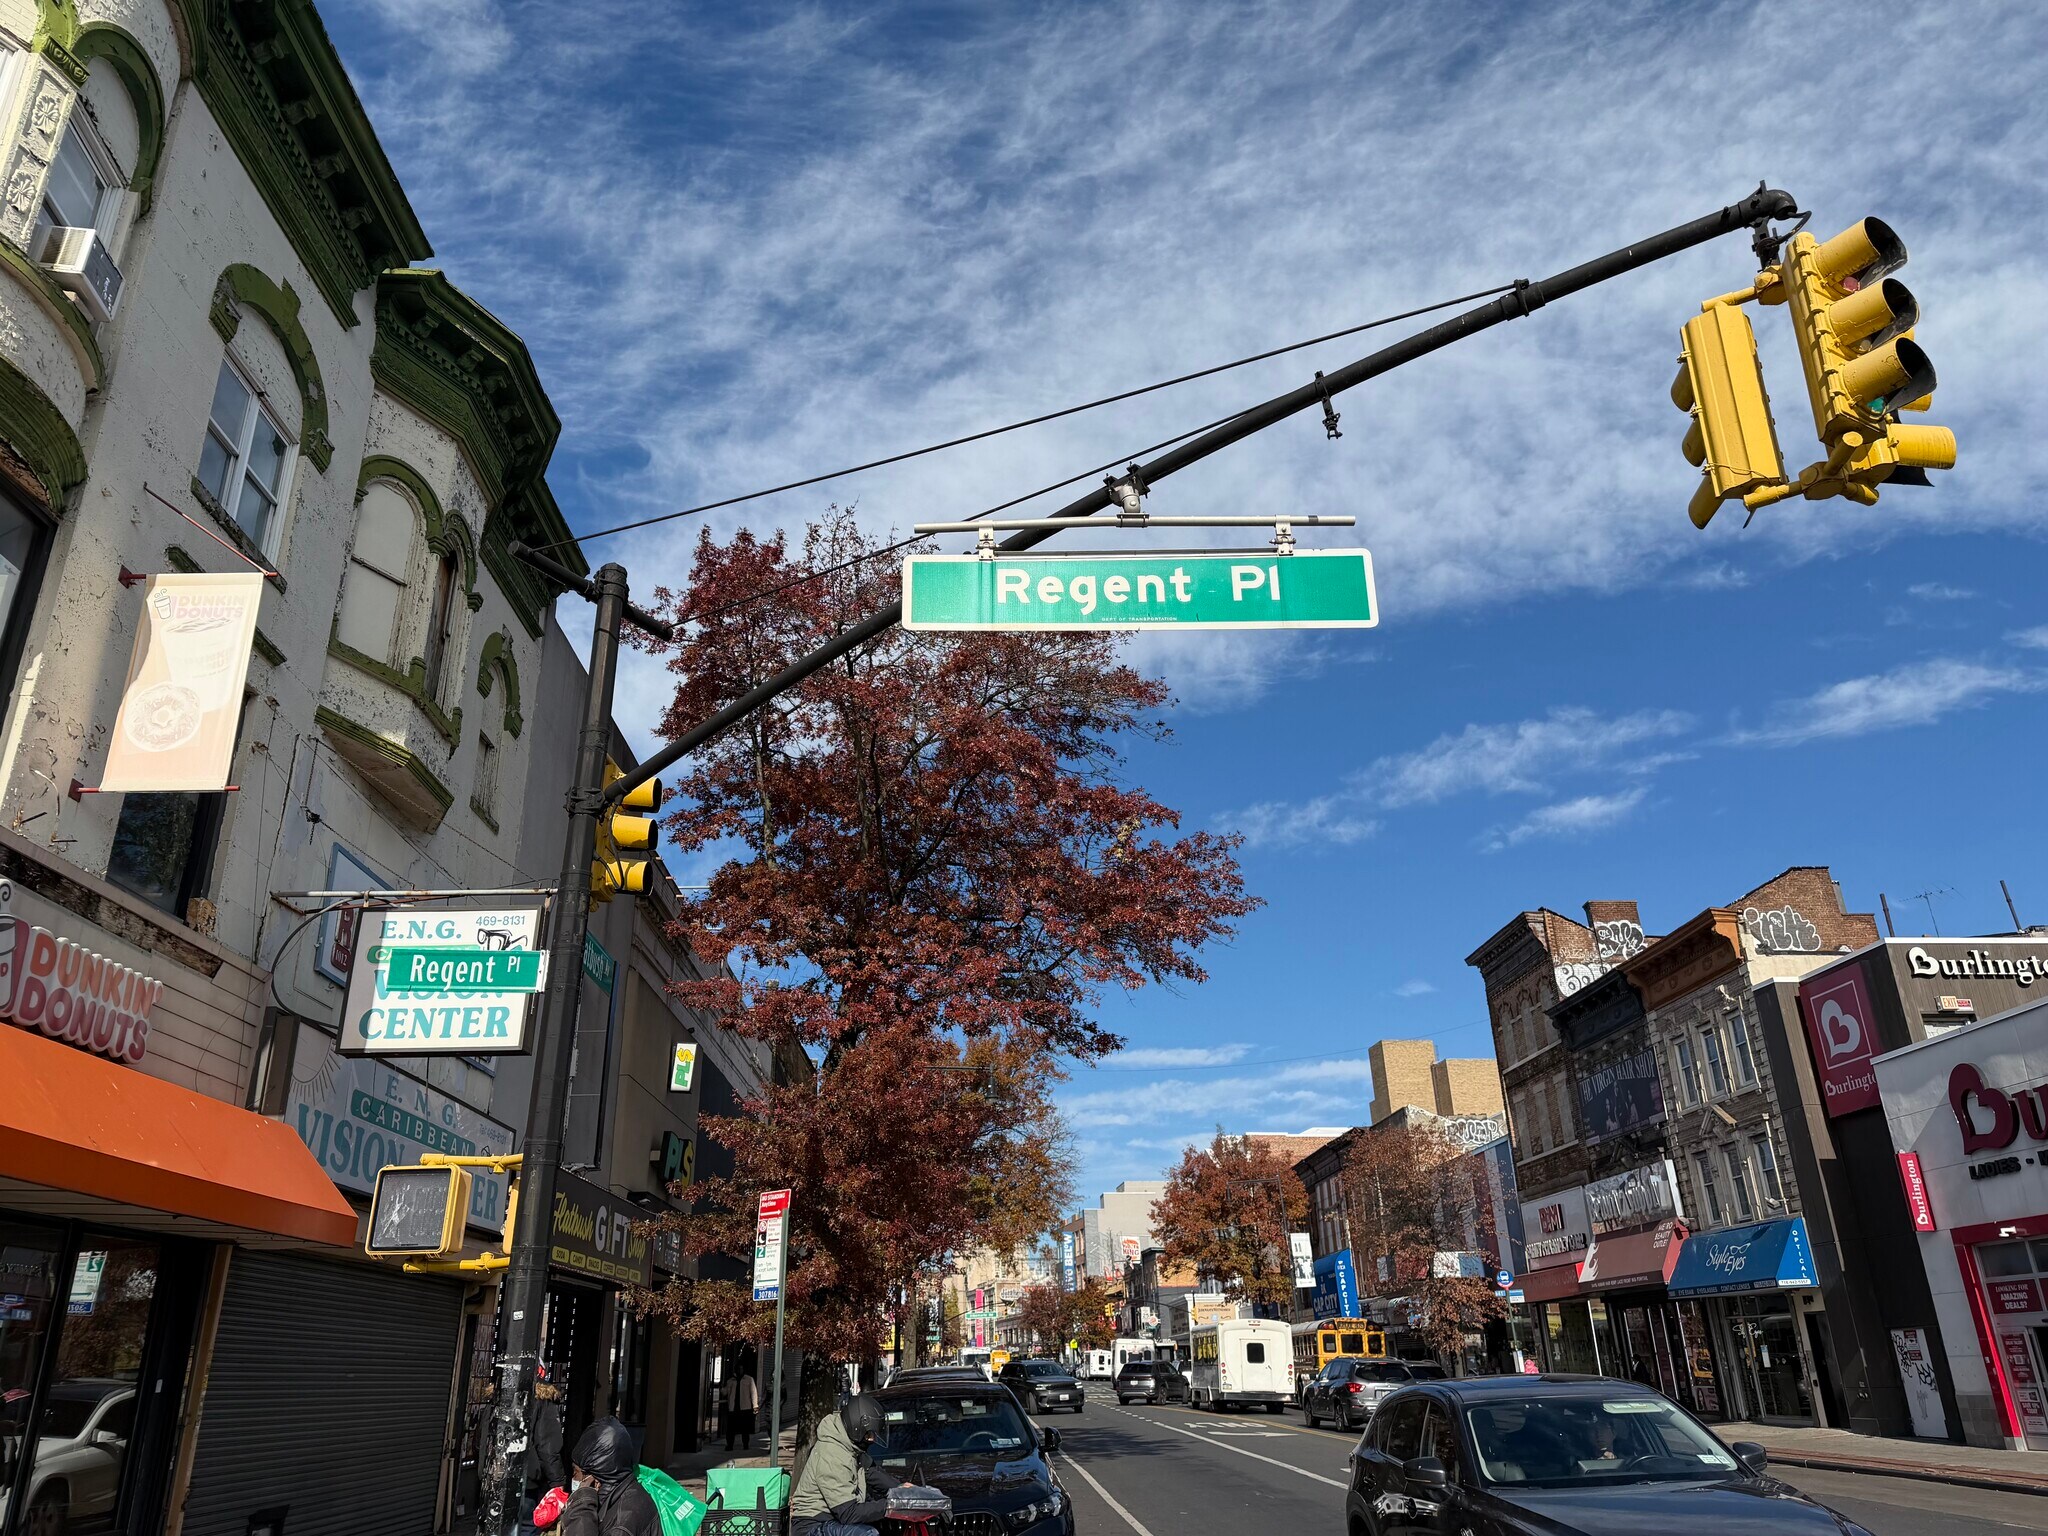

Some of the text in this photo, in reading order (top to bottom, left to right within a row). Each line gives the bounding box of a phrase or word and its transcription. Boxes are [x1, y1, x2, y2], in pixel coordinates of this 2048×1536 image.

[996, 565, 1280, 615] Regent Pl
[176, 606, 244, 618] DONUTS
[379, 915, 526, 939] E.N.G. 469-8131
[410, 954, 496, 991] Regent
[507, 955, 521, 973] Pl
[1942, 997, 1957, 1008] EXIT
[19, 976, 147, 1061] DONUTS
[359, 1006, 510, 1040] CENTER
[1615, 1060, 1636, 1080] HAIR
[1634, 1050, 1655, 1079] SHOP
[361, 1097, 470, 1157] CARIBBEAN
[299, 1103, 405, 1183] VISION
[1968, 1156, 2021, 1180] LADIES
[1905, 1159, 1929, 1226] Burlington
[553, 1191, 594, 1242] Flatbush
[595, 1204, 630, 1258] GIFT
[758, 1248, 765, 1257] 2
[1706, 1244, 1730, 1270] Style
[1724, 1256, 1747, 1276] Eyes
[1792, 1230, 1807, 1278] OPTICAL
[2000, 1292, 2028, 1301] AMAZING
[2005, 1301, 2028, 1310] DEALS?
